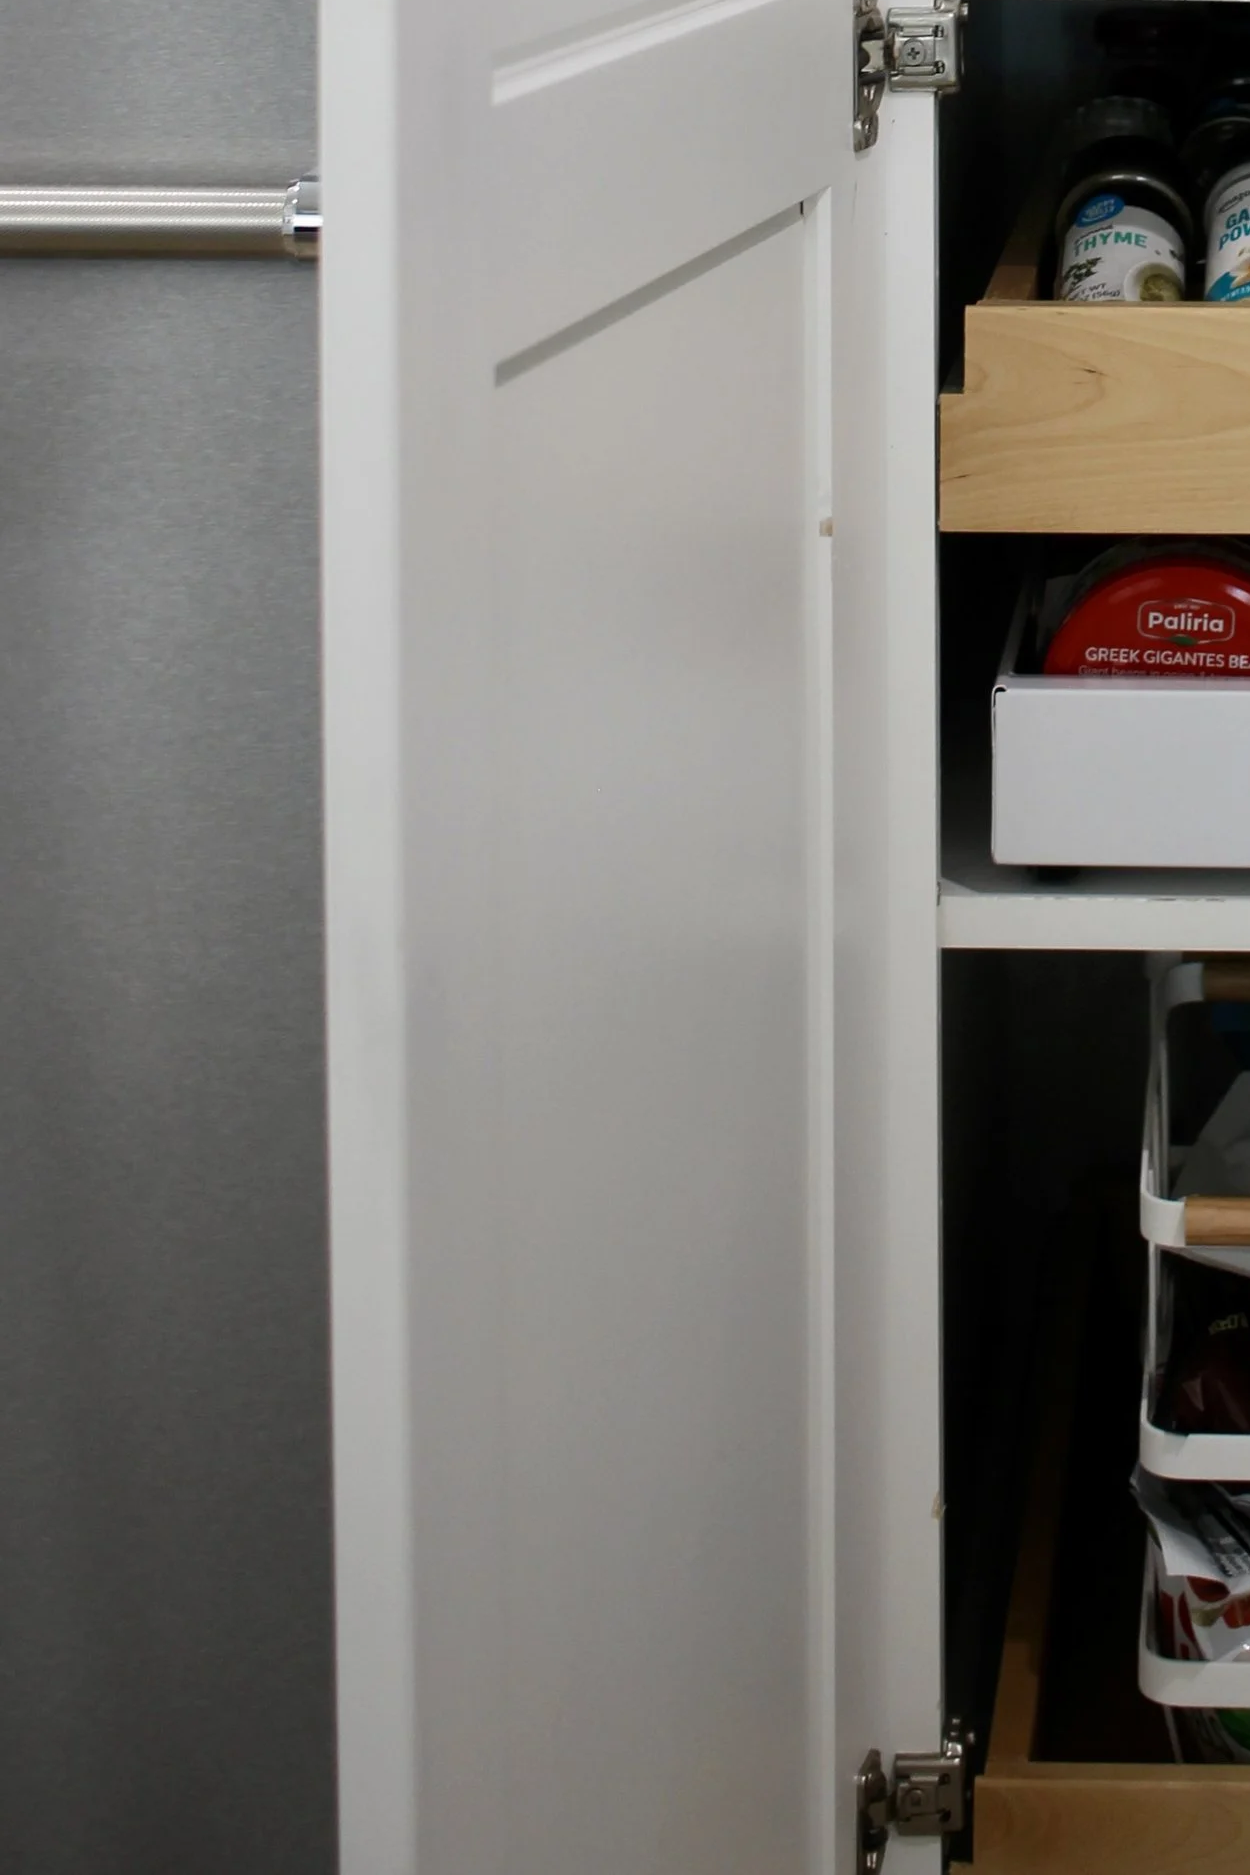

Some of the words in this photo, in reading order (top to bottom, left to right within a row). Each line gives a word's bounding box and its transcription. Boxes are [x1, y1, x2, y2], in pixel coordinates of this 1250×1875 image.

[1073, 230, 1148, 257] THYME
[1147, 611, 1225, 633] Paliria
[1084, 646, 1140, 664] GREEK
[1143, 649, 1225, 667] GIGANTES
